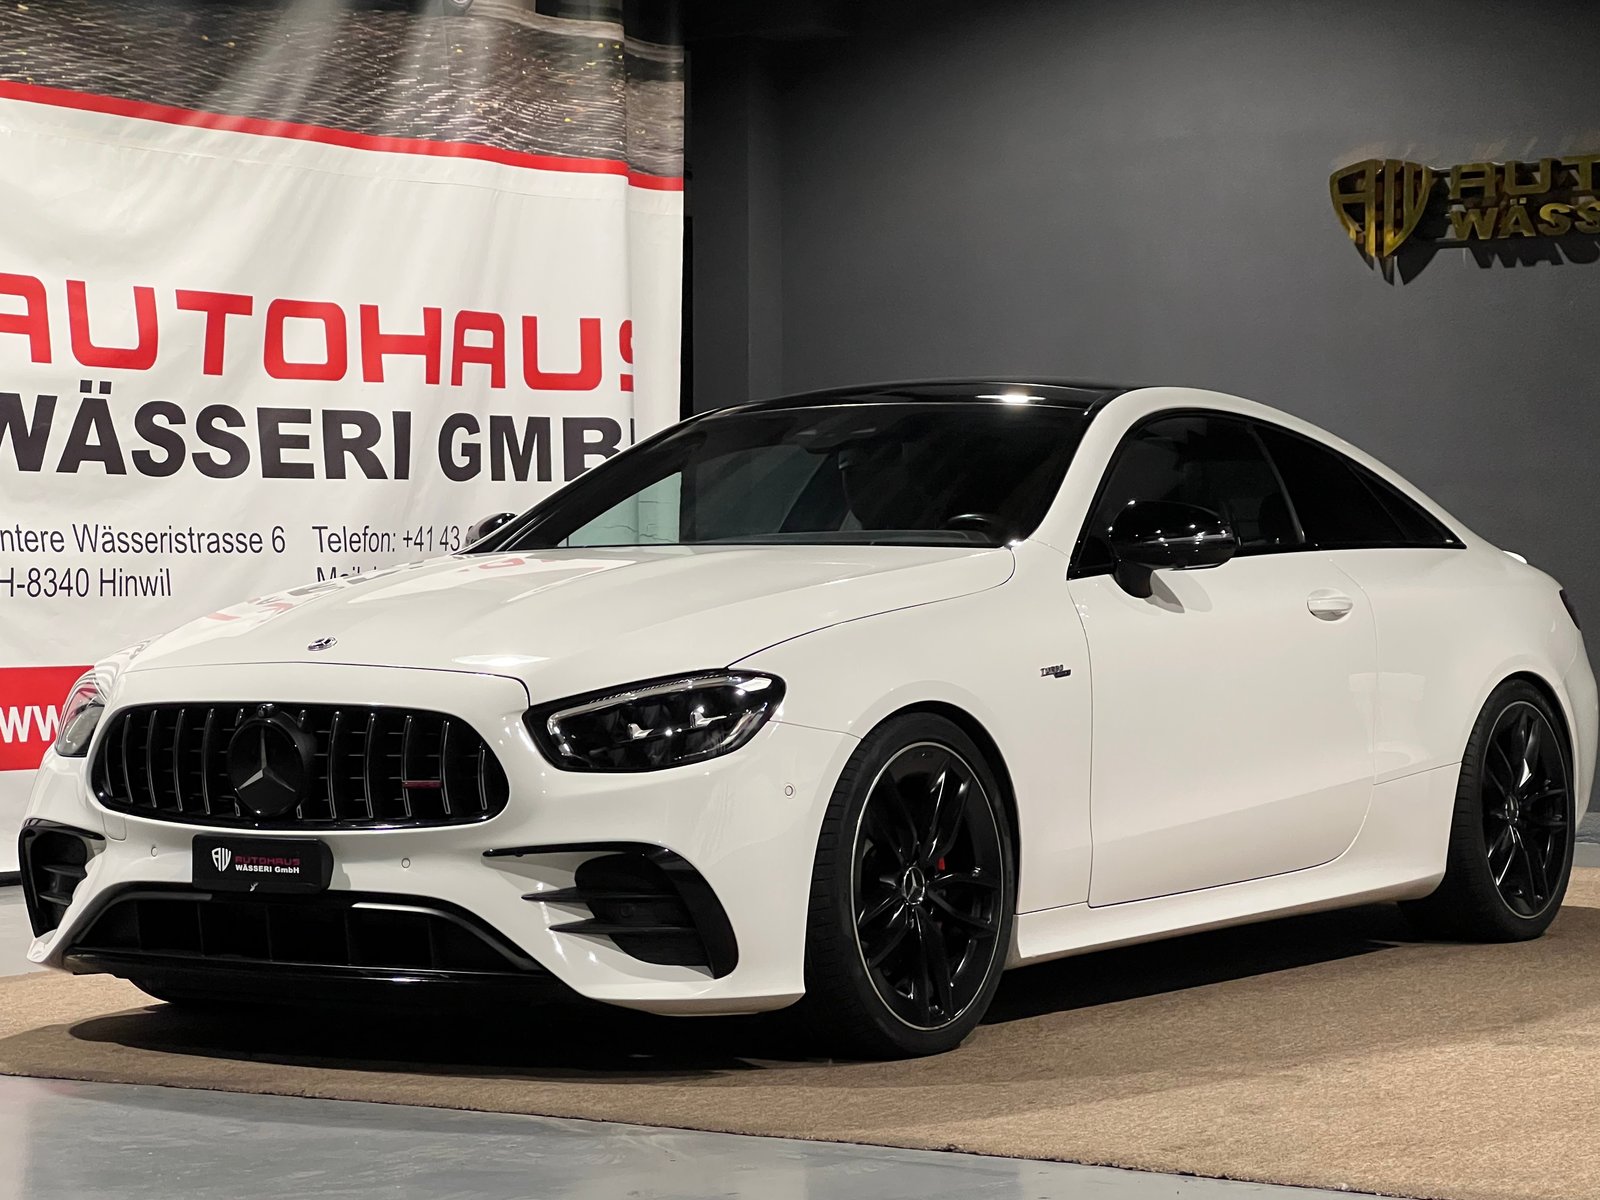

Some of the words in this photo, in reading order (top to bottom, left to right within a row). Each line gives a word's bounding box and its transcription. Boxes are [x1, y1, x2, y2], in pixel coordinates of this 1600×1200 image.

[0, 380, 411, 480] WÄSSERI
[438, 412, 635, 482] GMB
[72, 524, 263, 554] Wässeristrasse
[271, 525, 286, 553] 6
[312, 525, 396, 553] Telefon:
[403, 525, 433, 552] +41
[440, 525, 461, 552] 43
[100, 568, 171, 597] Hinwil
[234, 856, 300, 866] AUTOHAUS
[235, 863, 272, 873] WÄSSERI
[274, 866, 300, 874] GmbH
